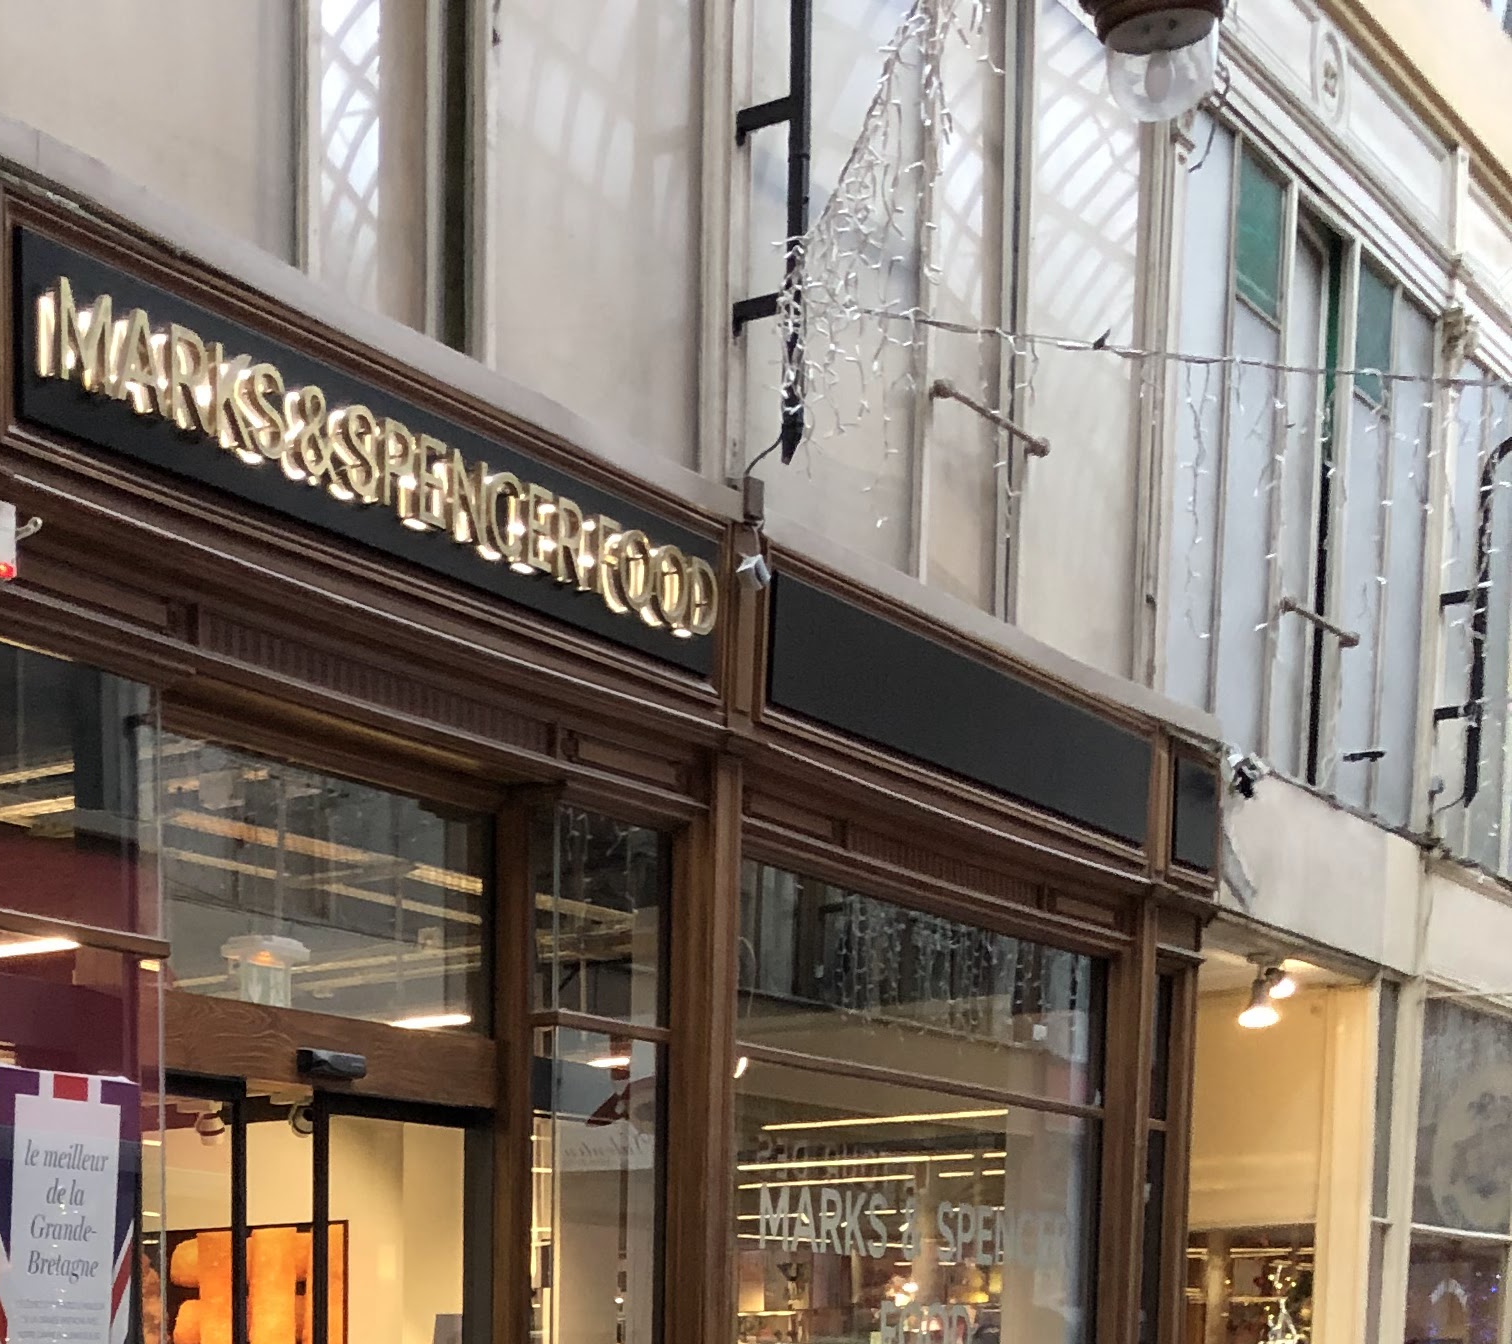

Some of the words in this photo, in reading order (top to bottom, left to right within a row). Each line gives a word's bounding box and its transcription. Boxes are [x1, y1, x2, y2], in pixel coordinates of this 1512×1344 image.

[598, 514, 719, 638] FOOD
[24, 1139, 40, 1167] le
[43, 1143, 109, 1172] meilleur
[46, 1177, 66, 1205] de
[69, 1179, 85, 1206] la
[30, 1213, 98, 1242] Grande-
[759, 1182, 888, 1259] MARKS
[27, 1249, 100, 1285] Bretagne
